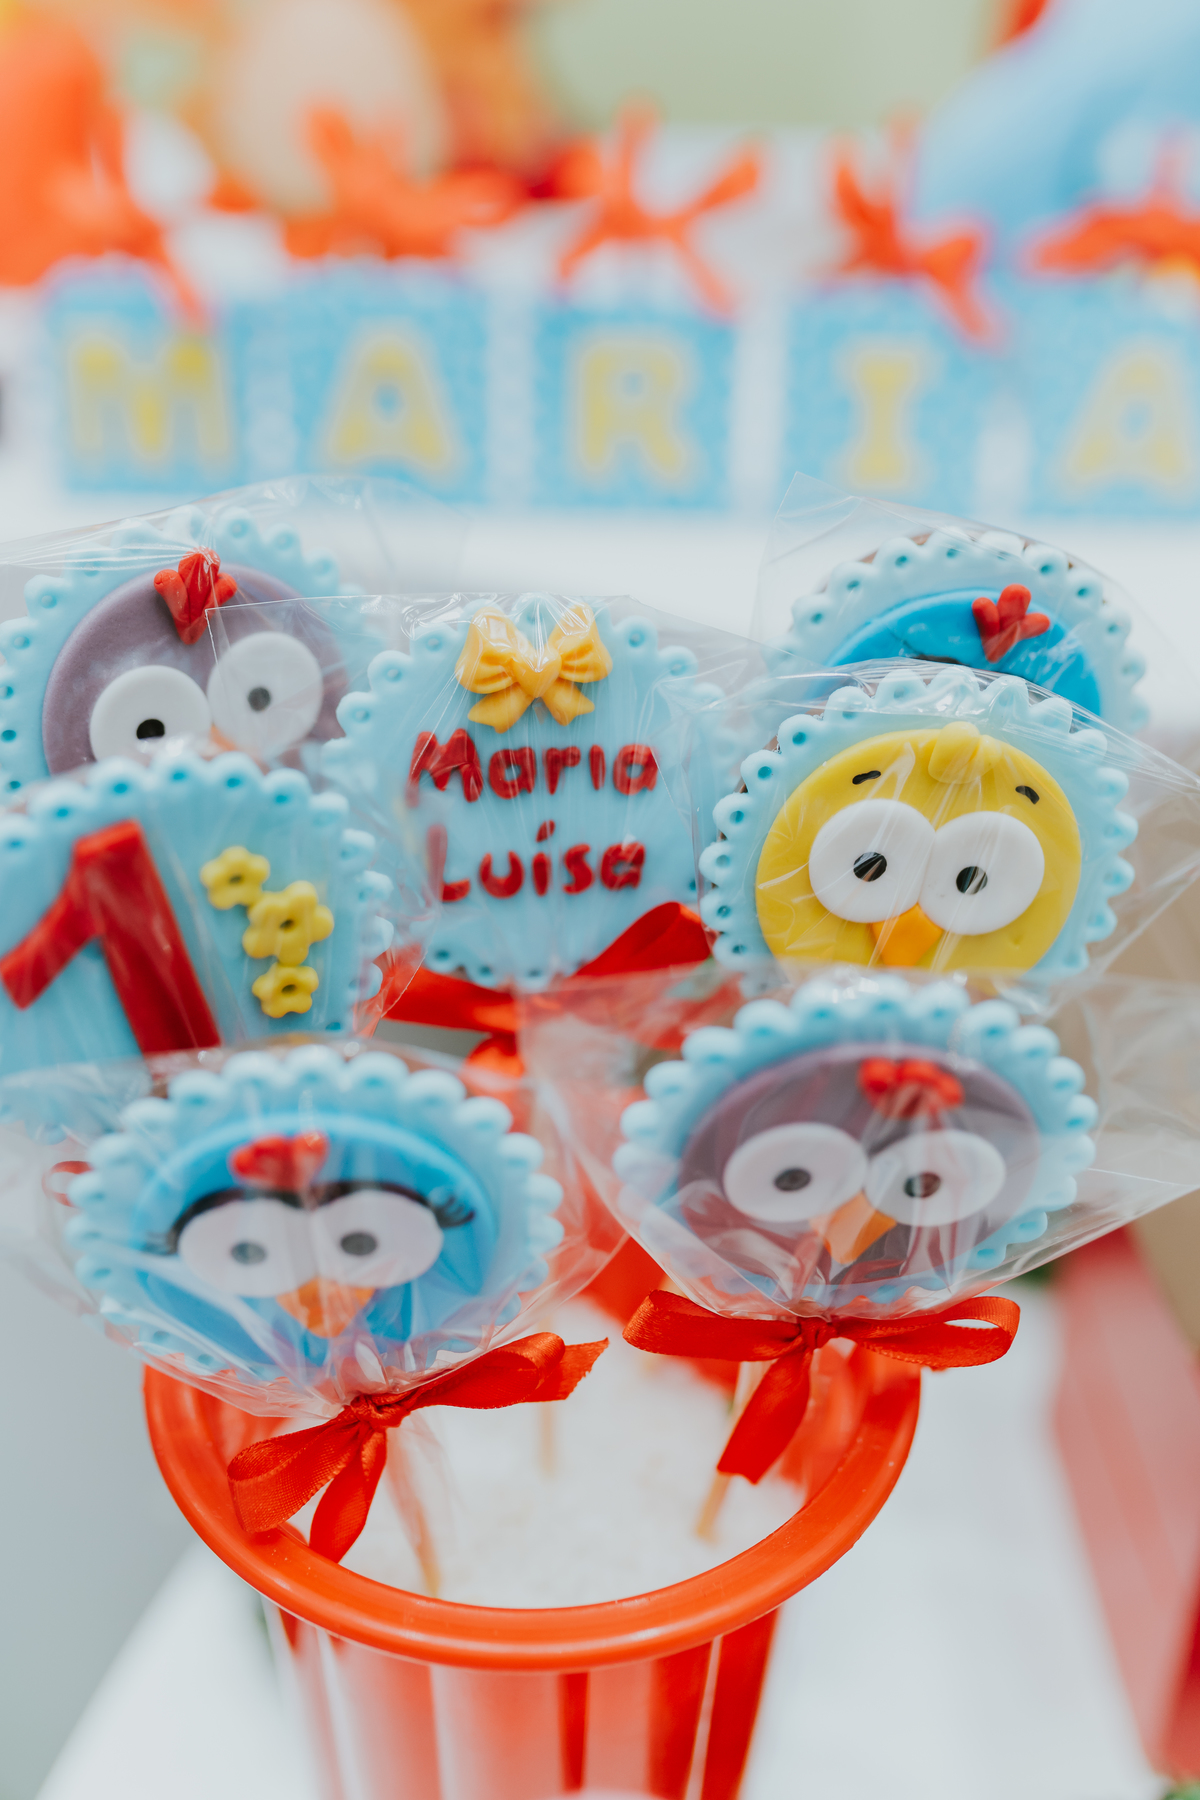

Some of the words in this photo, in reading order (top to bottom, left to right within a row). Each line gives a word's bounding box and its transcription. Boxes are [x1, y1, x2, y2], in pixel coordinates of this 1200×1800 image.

[64, 320, 1200, 490] MARIA
[405, 728, 659, 807] Maria
[426, 820, 646, 903] Luísa
[0, 817, 223, 1056] 1
